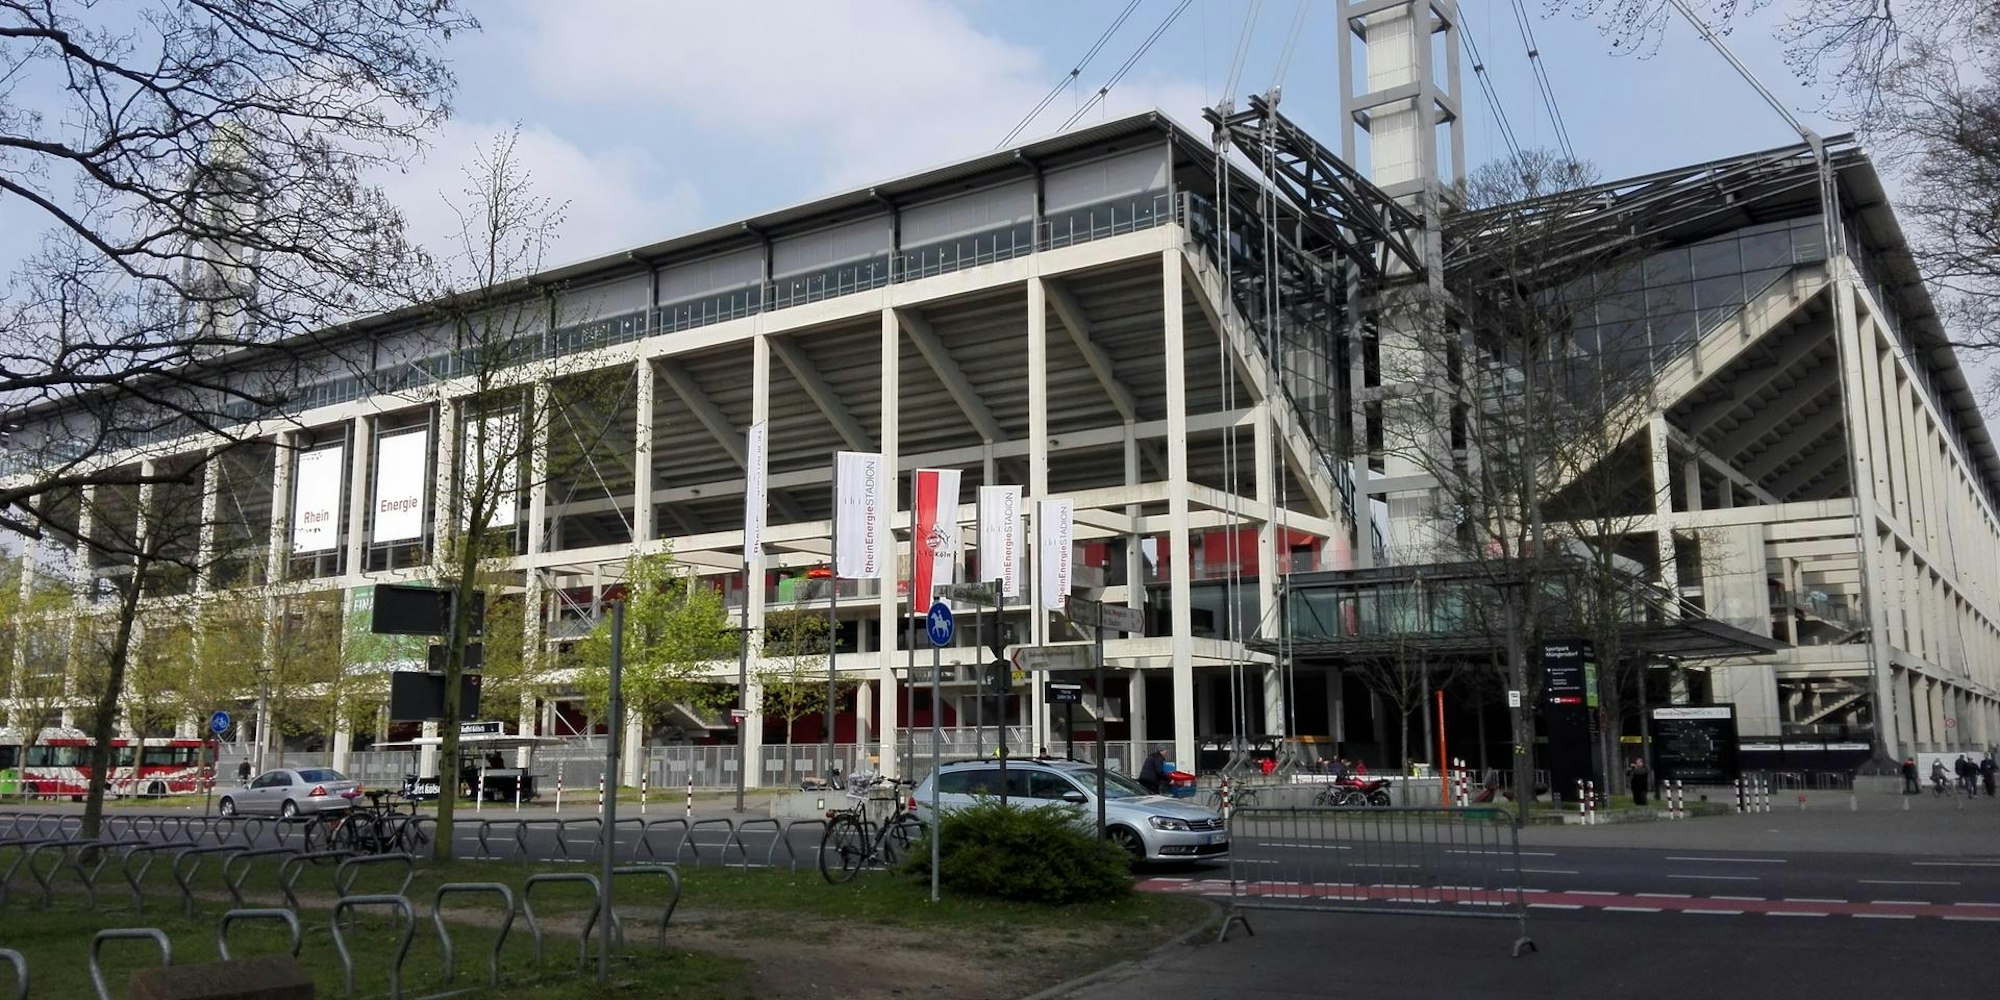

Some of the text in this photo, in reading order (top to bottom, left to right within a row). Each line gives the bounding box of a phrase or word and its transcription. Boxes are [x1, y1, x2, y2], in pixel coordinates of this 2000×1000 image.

[304, 509, 329, 524] Rhein
[380, 496, 418, 512] Energie
[865, 460, 875, 573] RheinEnergieSTADION
[1003, 492, 1014, 592] RheinEnergieSTADION
[1058, 506, 1067, 603] RheinEnergieSTADION
